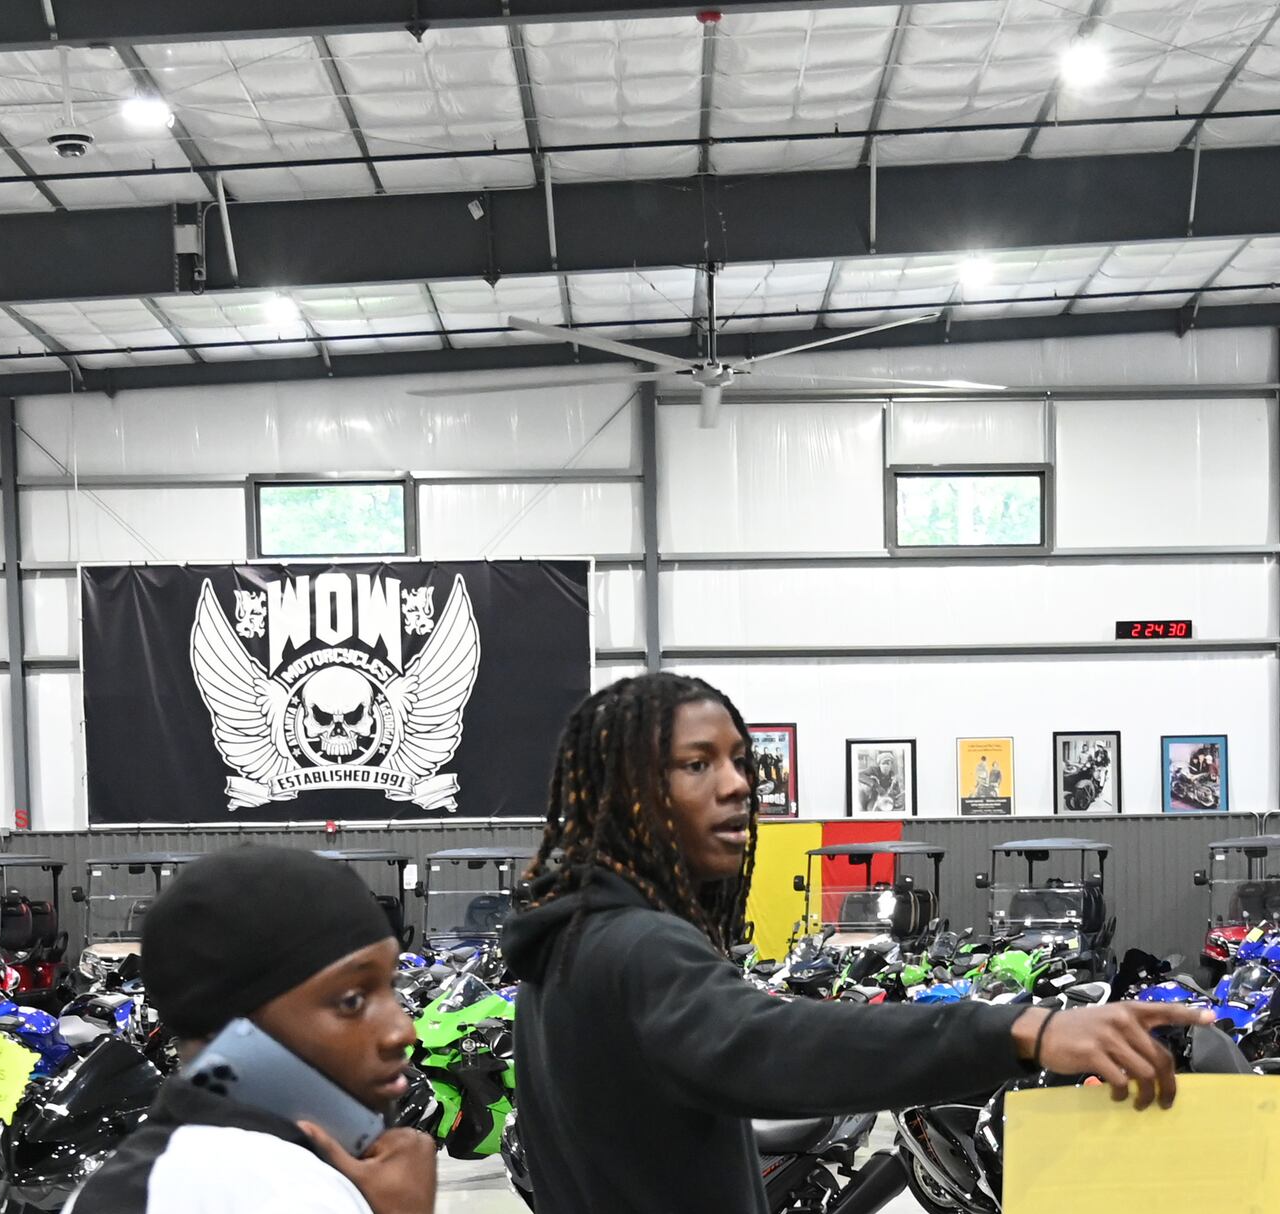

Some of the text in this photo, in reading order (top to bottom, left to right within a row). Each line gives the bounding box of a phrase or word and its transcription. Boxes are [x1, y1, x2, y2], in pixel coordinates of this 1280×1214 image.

[266, 572, 403, 678] WOW
[280, 648, 394, 684] MOTORCYCLES
[284, 706, 299, 747] ATLANTA
[379, 702, 395, 746] GEORGIA
[277, 769, 406, 790] ESTABLISHED 1991
